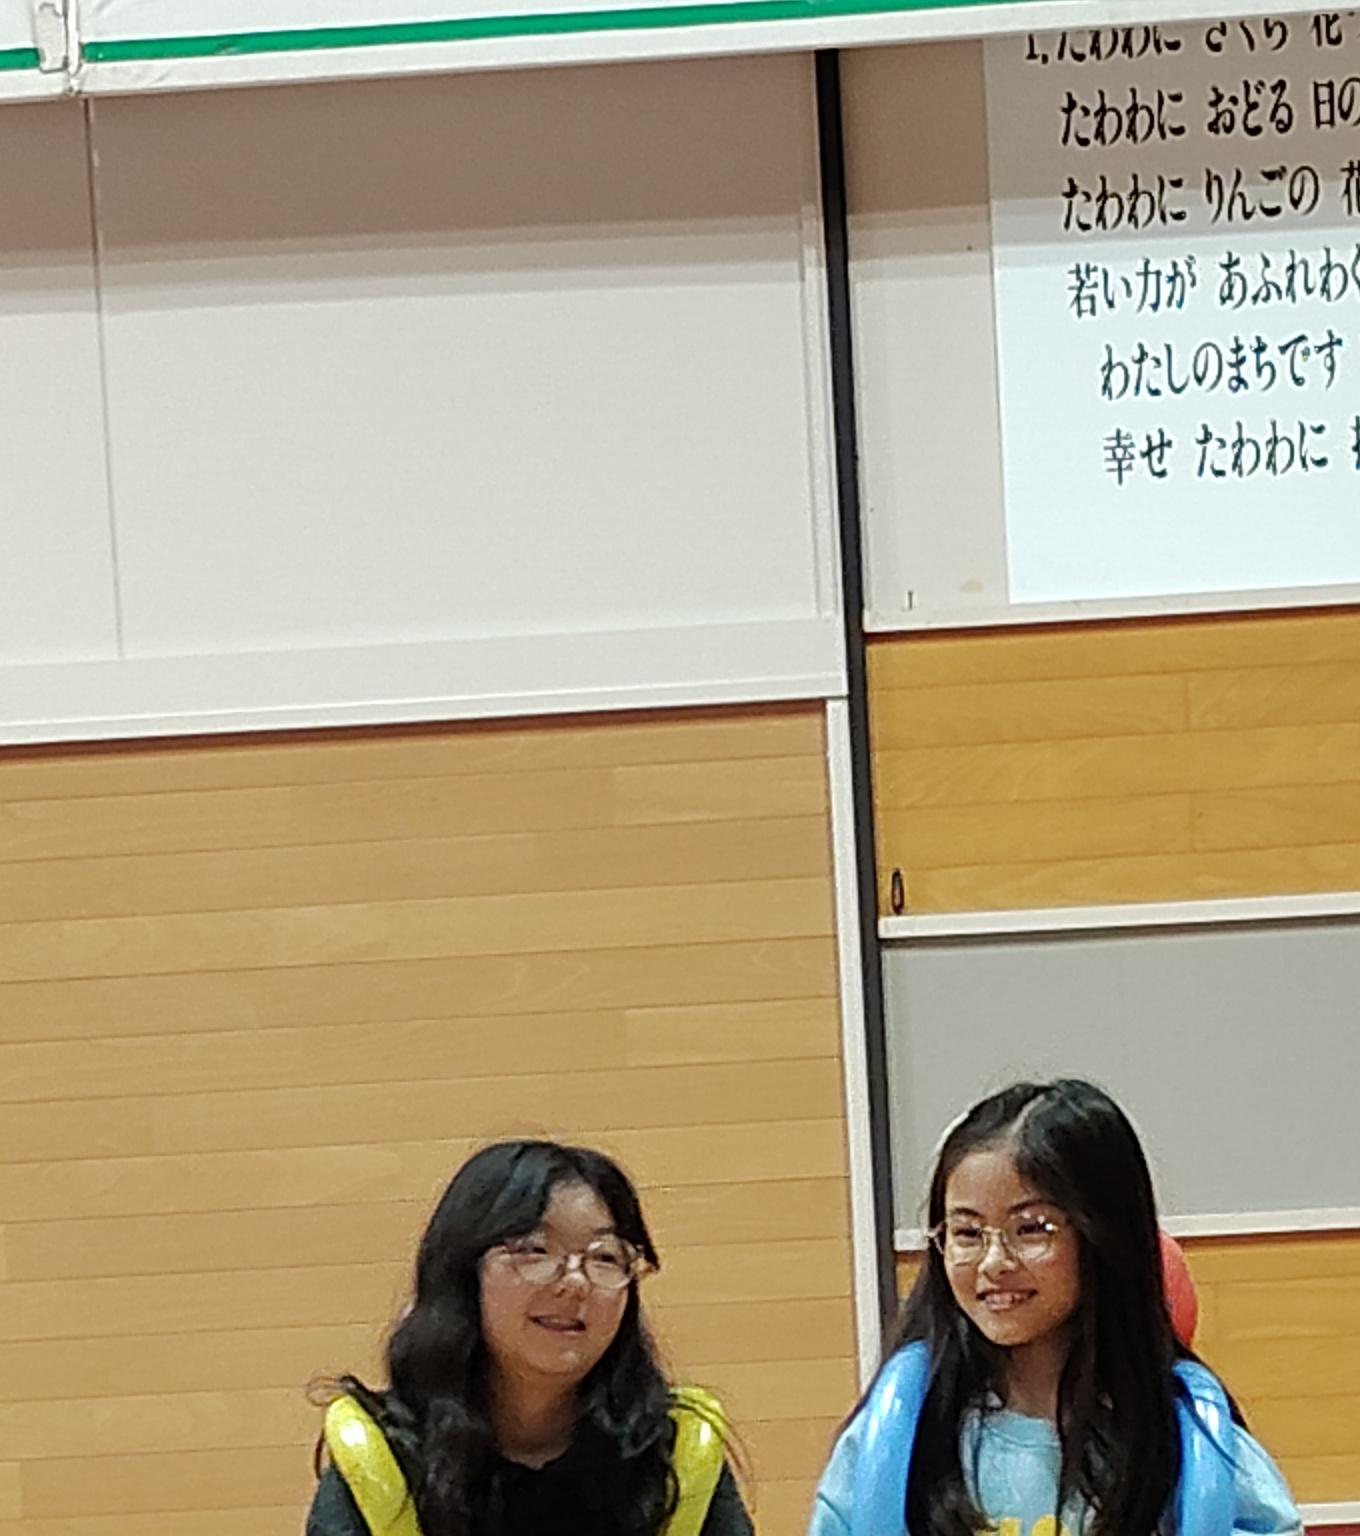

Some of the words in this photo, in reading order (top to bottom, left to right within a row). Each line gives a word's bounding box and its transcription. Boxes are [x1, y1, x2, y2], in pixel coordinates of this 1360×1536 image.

[1060, 87, 1186, 148] たわわに
[1207, 78, 1294, 137] おどる
[1061, 172, 1187, 233] たわわに
[1205, 165, 1320, 225] りんごの
[1067, 254, 1197, 320] 若い力が
[1100, 329, 1344, 401] わたしのまちです
[1103, 427, 1173, 487] 幸せ
[1194, 419, 1329, 479] たわわに
